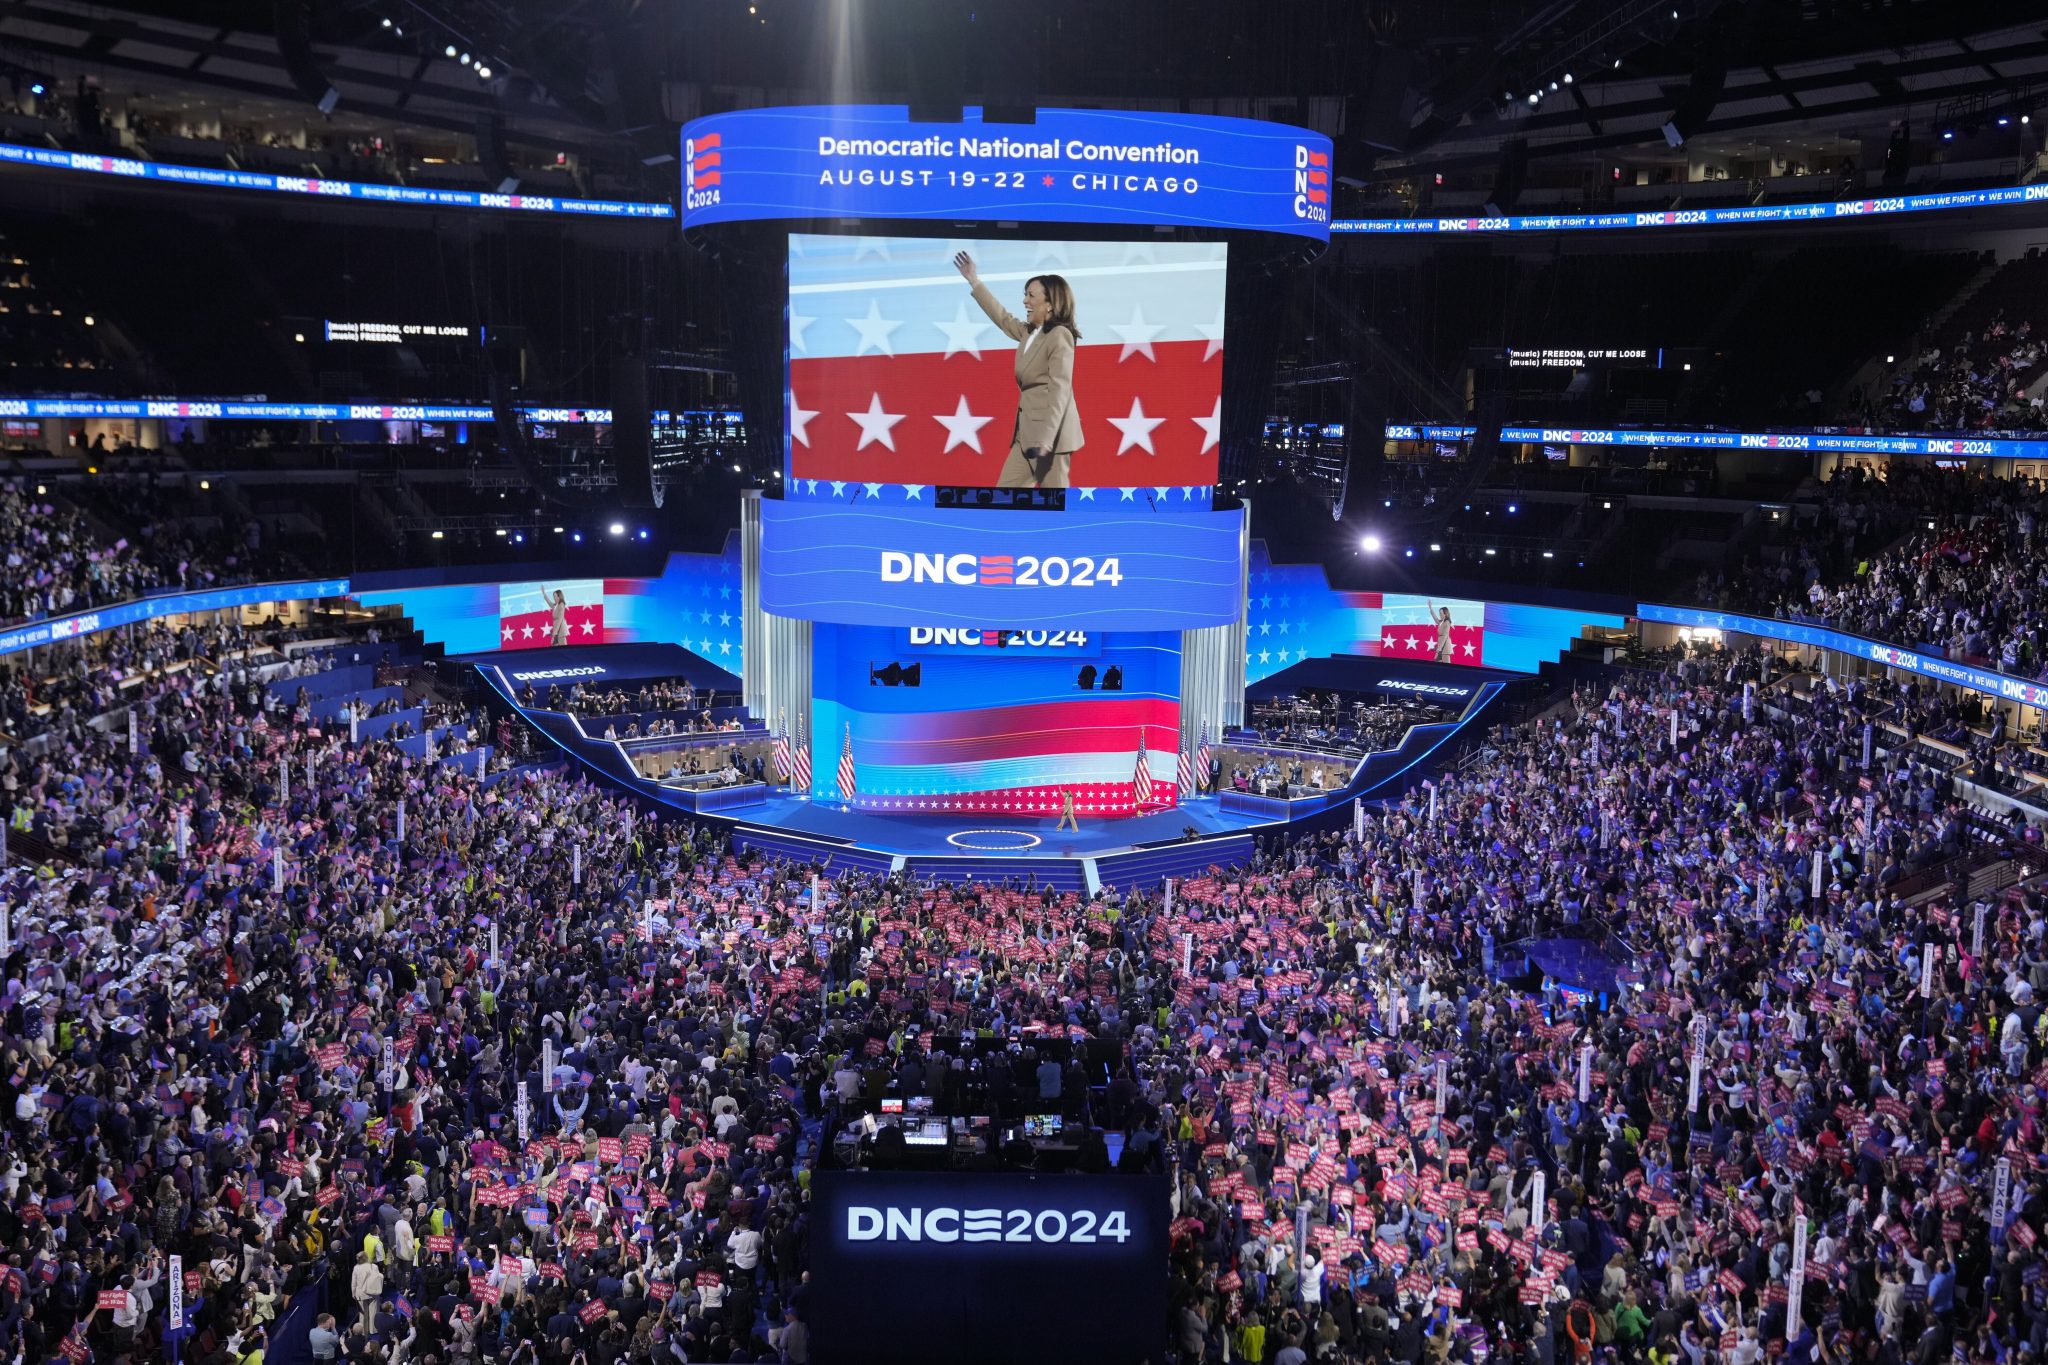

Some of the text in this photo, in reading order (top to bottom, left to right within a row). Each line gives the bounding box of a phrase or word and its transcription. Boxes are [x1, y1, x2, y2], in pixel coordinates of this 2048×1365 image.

[818, 136, 1199, 165] Democratic National Convention
[112, 158, 145, 175] 2024
[276, 176, 352, 197] DNC 2024
[820, 170, 1200, 194] AUGUST 19-22 CHICAGO
[480, 193, 554, 210] DNC 2024
[562, 201, 587, 211] WHEN
[694, 189, 721, 208] 2024
[1911, 191, 2022, 208] WHEN WE FIGHT WE WIN
[1307, 202, 1327, 224] 2024
[1716, 207, 1825, 220] WHEN WE FIGHT WE WIN
[1835, 199, 1905, 215] DNC 2024
[1438, 218, 1510, 231] DNC 2024
[1523, 219, 1548, 228] WHEN
[1562, 218, 1586, 226] FIGHT
[1598, 217, 1612, 225] WE
[1613, 216, 1628, 225] WIN
[1636, 211, 1707, 225] DNC 2024
[1354, 222, 1368, 230] WE
[1368, 222, 1392, 230] FIGHT
[1403, 222, 1417, 230] WE
[403, 325, 421, 334] CUT
[423, 326, 436, 335] ME
[438, 327, 468, 336] LOOSE
[1510, 350, 1646, 358] (music) FREEDOM, CUT ME LOOSE
[1509, 359, 1585, 367] (music) FREEDOM,
[147, 402, 222, 417] DNC 2024
[350, 406, 424, 419] DNC 2024
[427, 409, 493, 419] WHEN WE FIGHT
[1542, 430, 1614, 443] DNC 2024
[1626, 435, 1649, 443] WHEN
[1667, 436, 1691, 444] FIGHT
[1703, 436, 1717, 444] WE
[1718, 437, 1733, 445] WIN
[1740, 435, 1809, 449] DNC 2024
[1817, 439, 1841, 448] WHEN
[1842, 440, 1855, 448] WE
[1857, 440, 1880, 449] FIGHT
[1927, 440, 1992, 455] DNC 2024
[881, 551, 1123, 587] DNC 2024
[1873, 645, 1917, 669] DNC 2024
[563, 666, 607, 676] 2024
[1923, 661, 1998, 690] WHEN WE FIGHT WE WIN
[1424, 685, 1470, 696] 2024
[2002, 680, 2026, 699] DNC
[1994, 1167, 2007, 1218] TEXAS
[848, 1206, 1131, 1243] DNC 2024
[172, 1265, 181, 1319] ARIZONA
